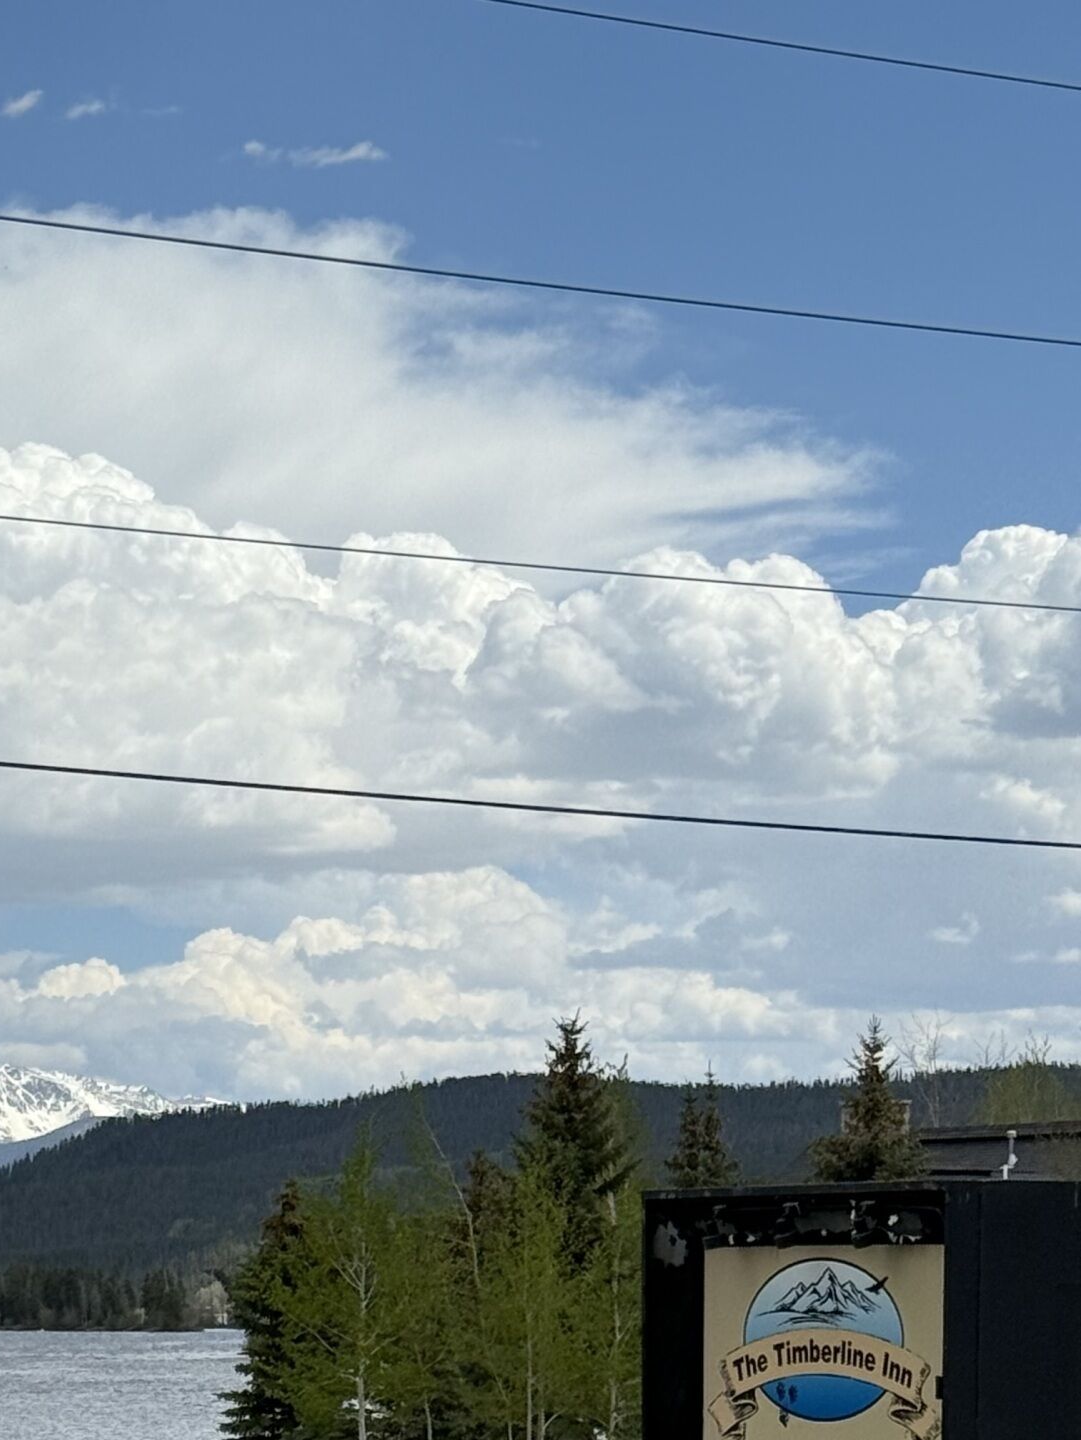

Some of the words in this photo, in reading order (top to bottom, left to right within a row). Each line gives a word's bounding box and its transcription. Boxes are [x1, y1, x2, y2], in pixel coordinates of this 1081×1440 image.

[732, 1353, 769, 1382] The
[773, 1338, 876, 1372] Timberline
[882, 1352, 913, 1388] Inn
